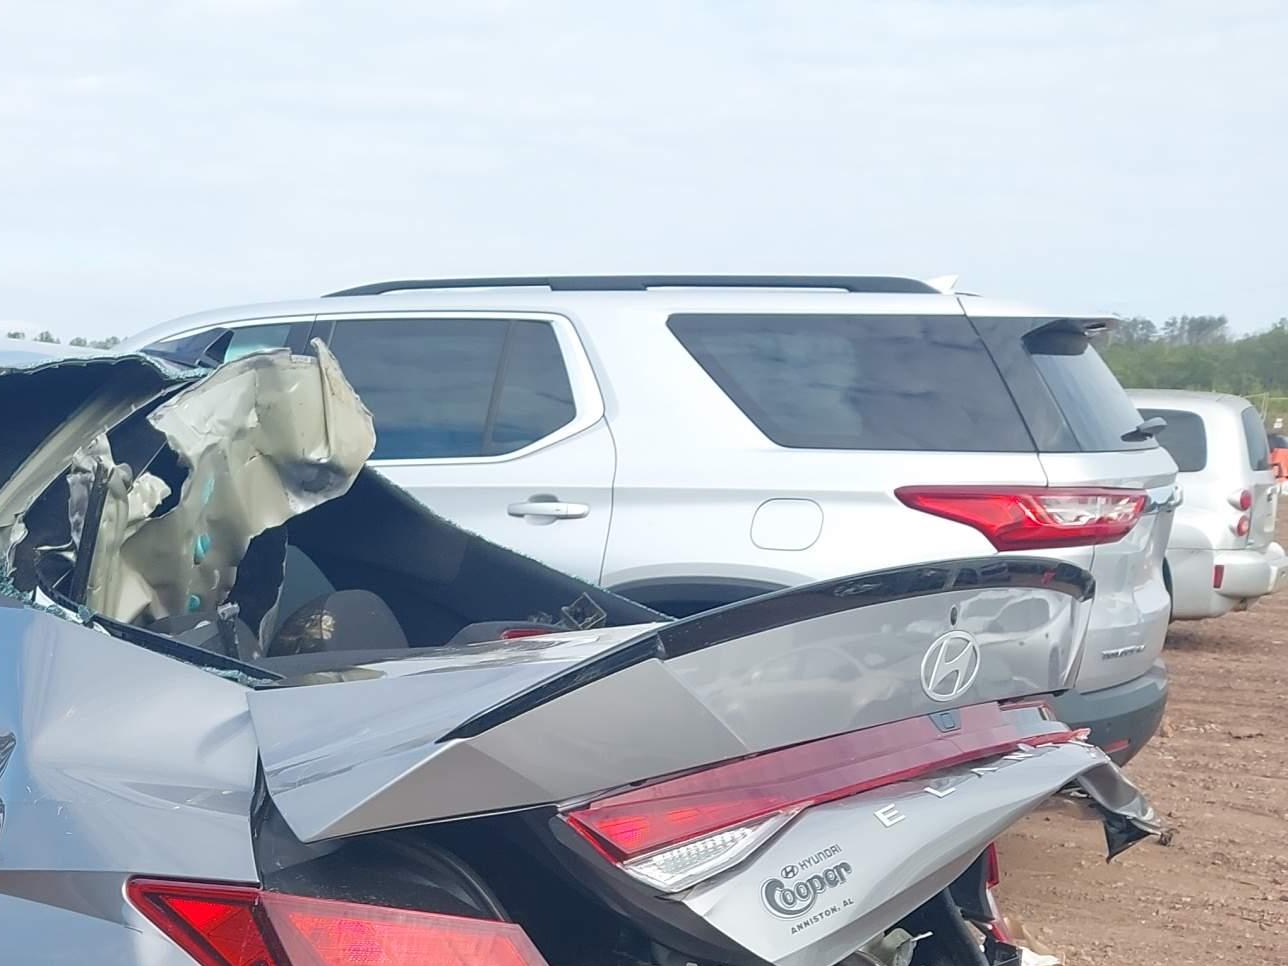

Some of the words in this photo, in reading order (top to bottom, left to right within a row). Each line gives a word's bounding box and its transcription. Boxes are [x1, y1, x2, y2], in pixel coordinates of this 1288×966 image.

[797, 843, 843, 871] HYUNDAI
[760, 860, 853, 920] Cooper
[790, 904, 842, 935] ANNISTON,
[842, 897, 855, 908] AL
